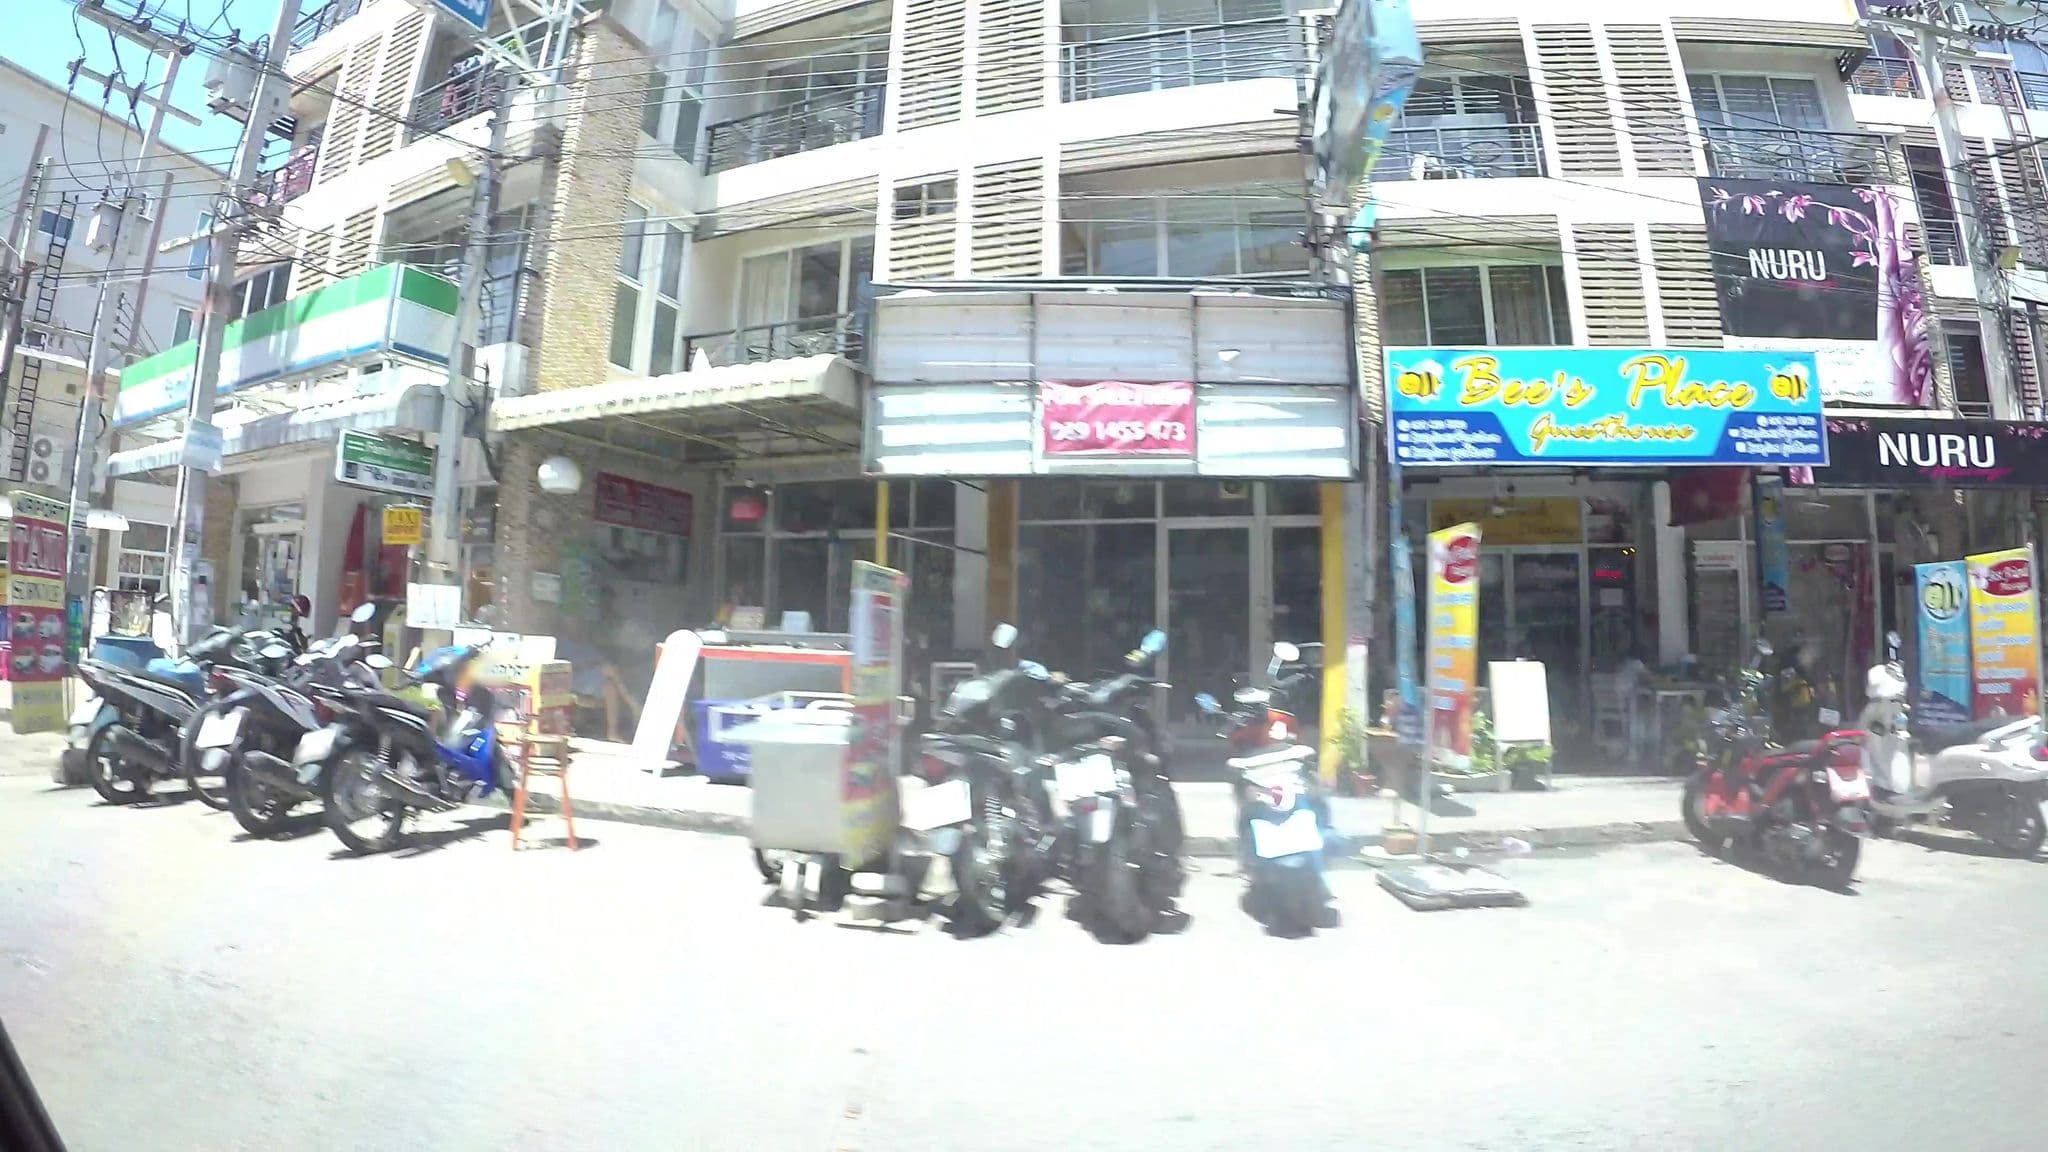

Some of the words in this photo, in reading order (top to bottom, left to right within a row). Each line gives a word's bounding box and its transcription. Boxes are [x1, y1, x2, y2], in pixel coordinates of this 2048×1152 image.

[1748, 248, 1827, 282] NURU
[1453, 355, 1594, 406] Bee's
[1621, 354, 1756, 408] Place
[1878, 432, 1997, 469] NURU
